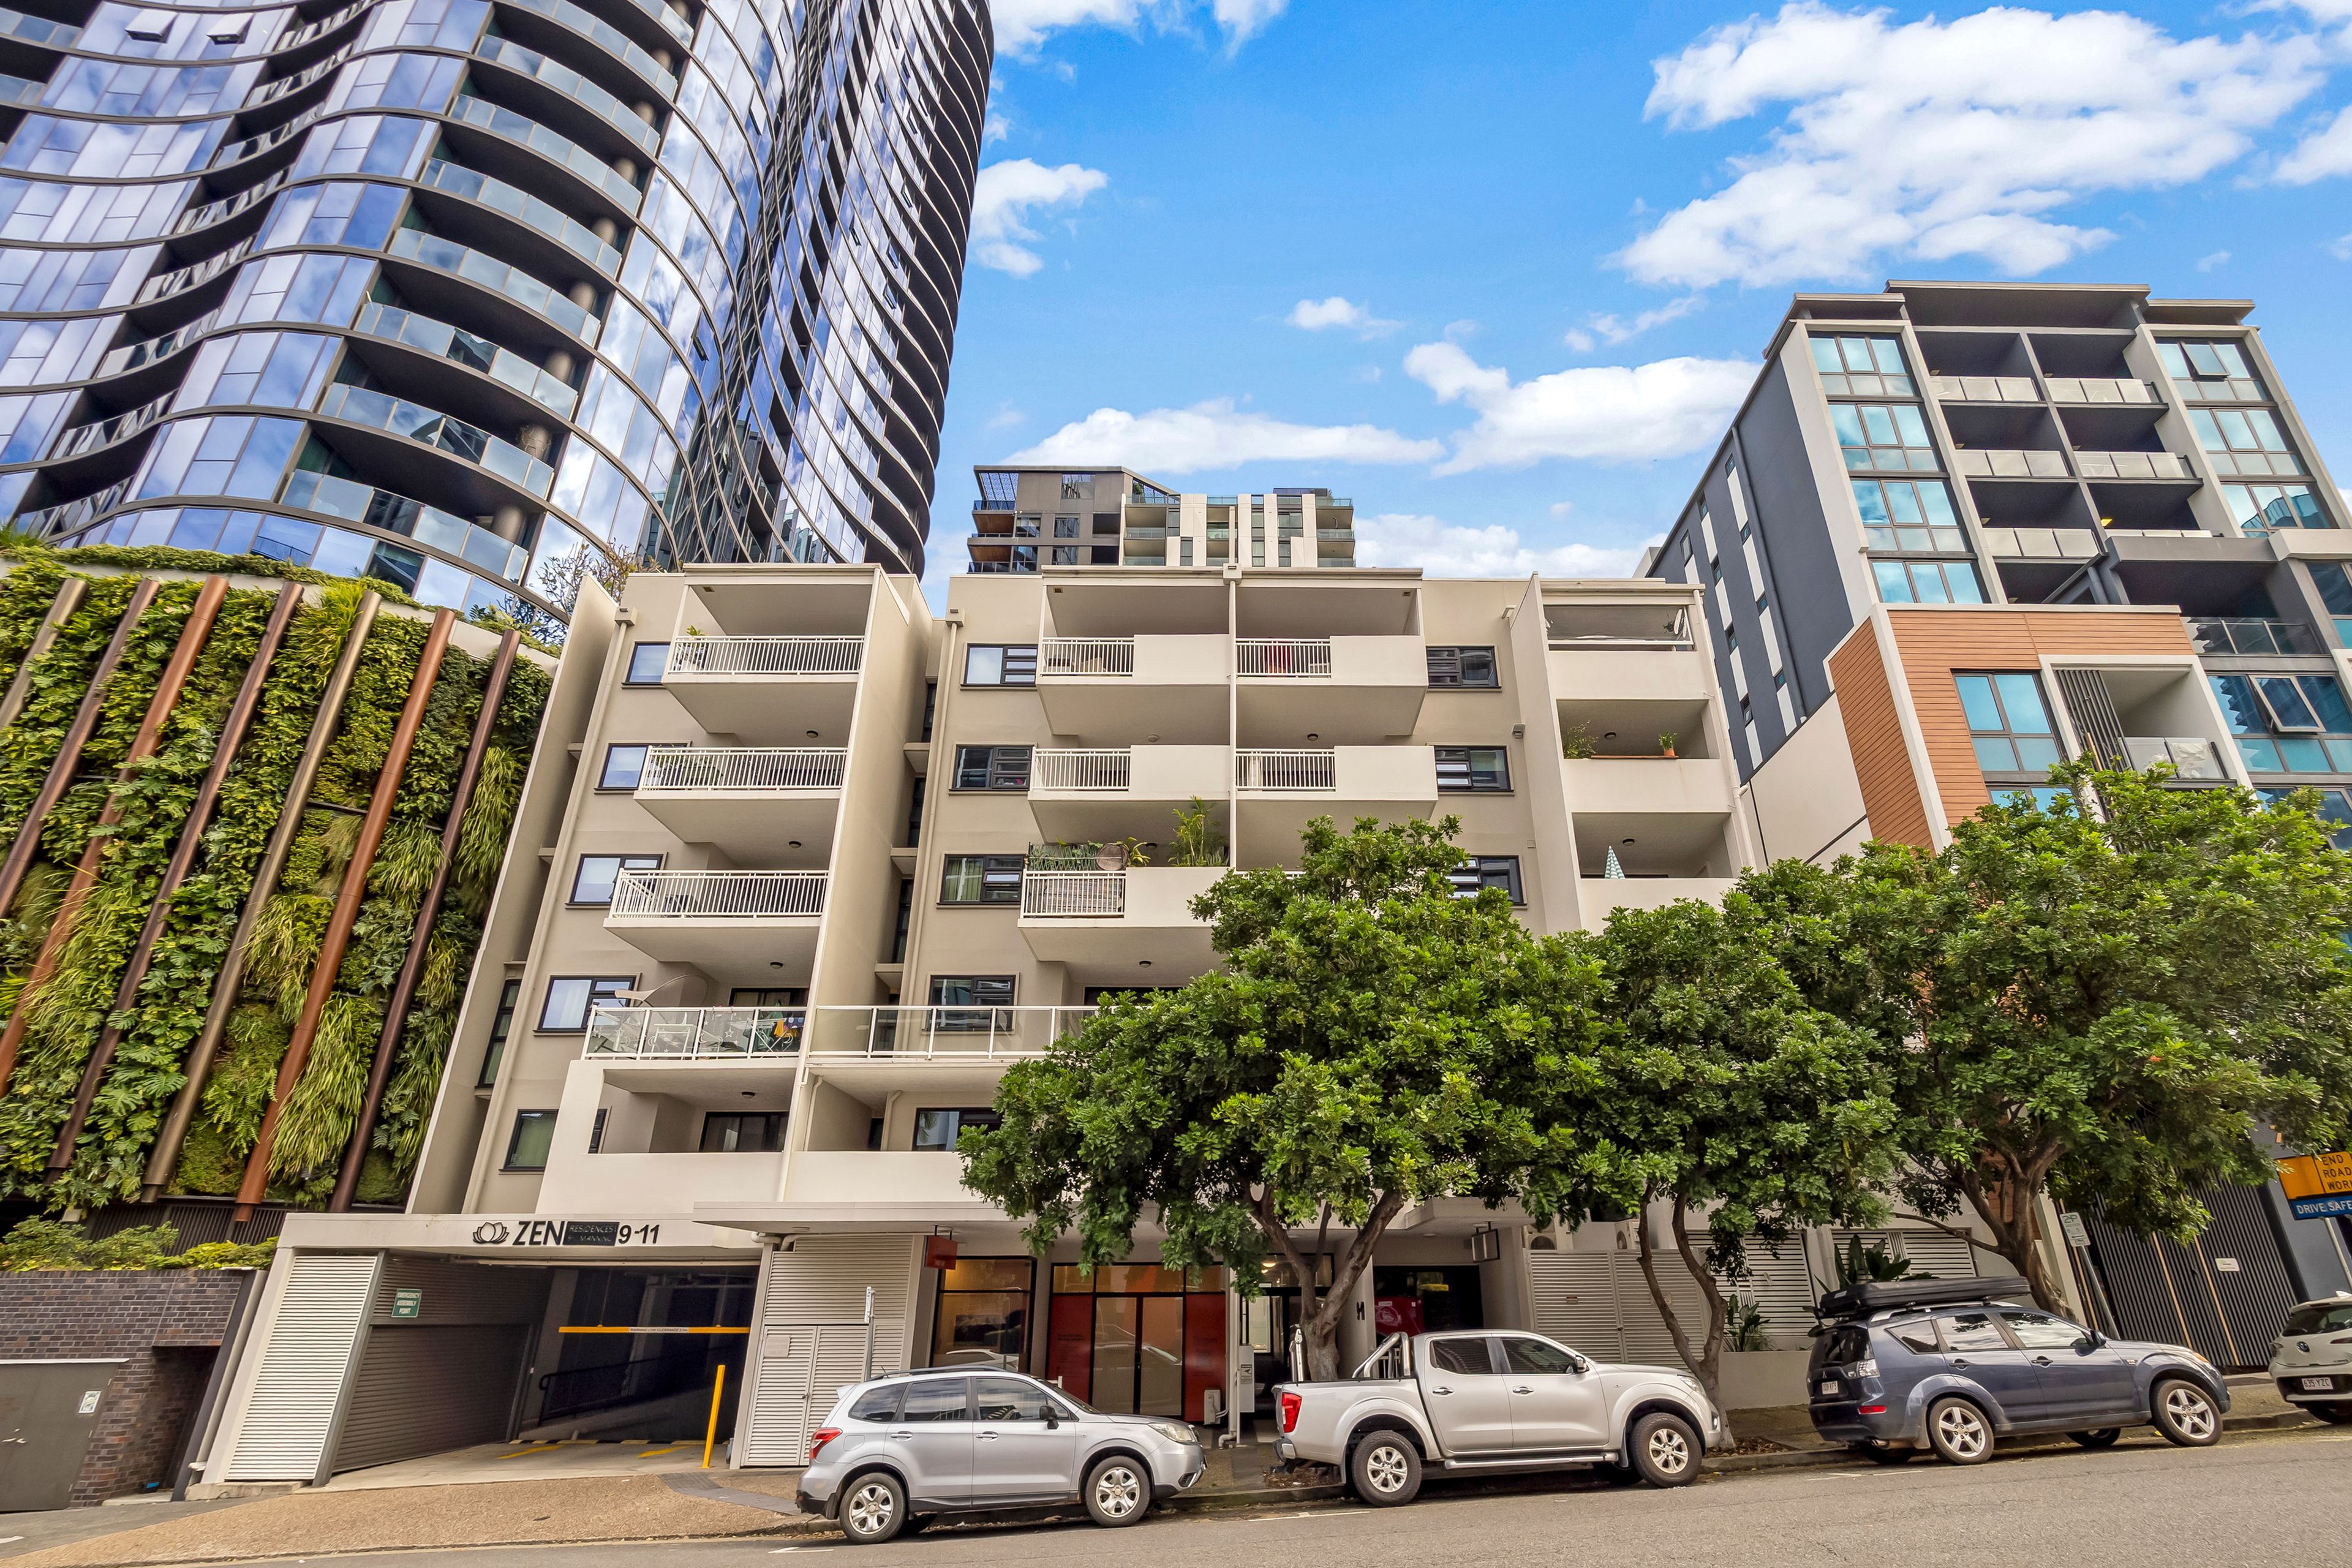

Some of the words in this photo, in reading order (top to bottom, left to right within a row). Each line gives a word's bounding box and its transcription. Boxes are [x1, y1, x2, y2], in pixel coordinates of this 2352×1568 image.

[2321, 1155, 2344, 1166] END
[2323, 1167, 2352, 1178] ROAD
[2296, 1203, 2327, 1214] DRIVE
[2062, 1215, 2077, 1223] 2P
[512, 1221, 565, 1246] ZEN
[618, 1224, 660, 1244] 9-11
